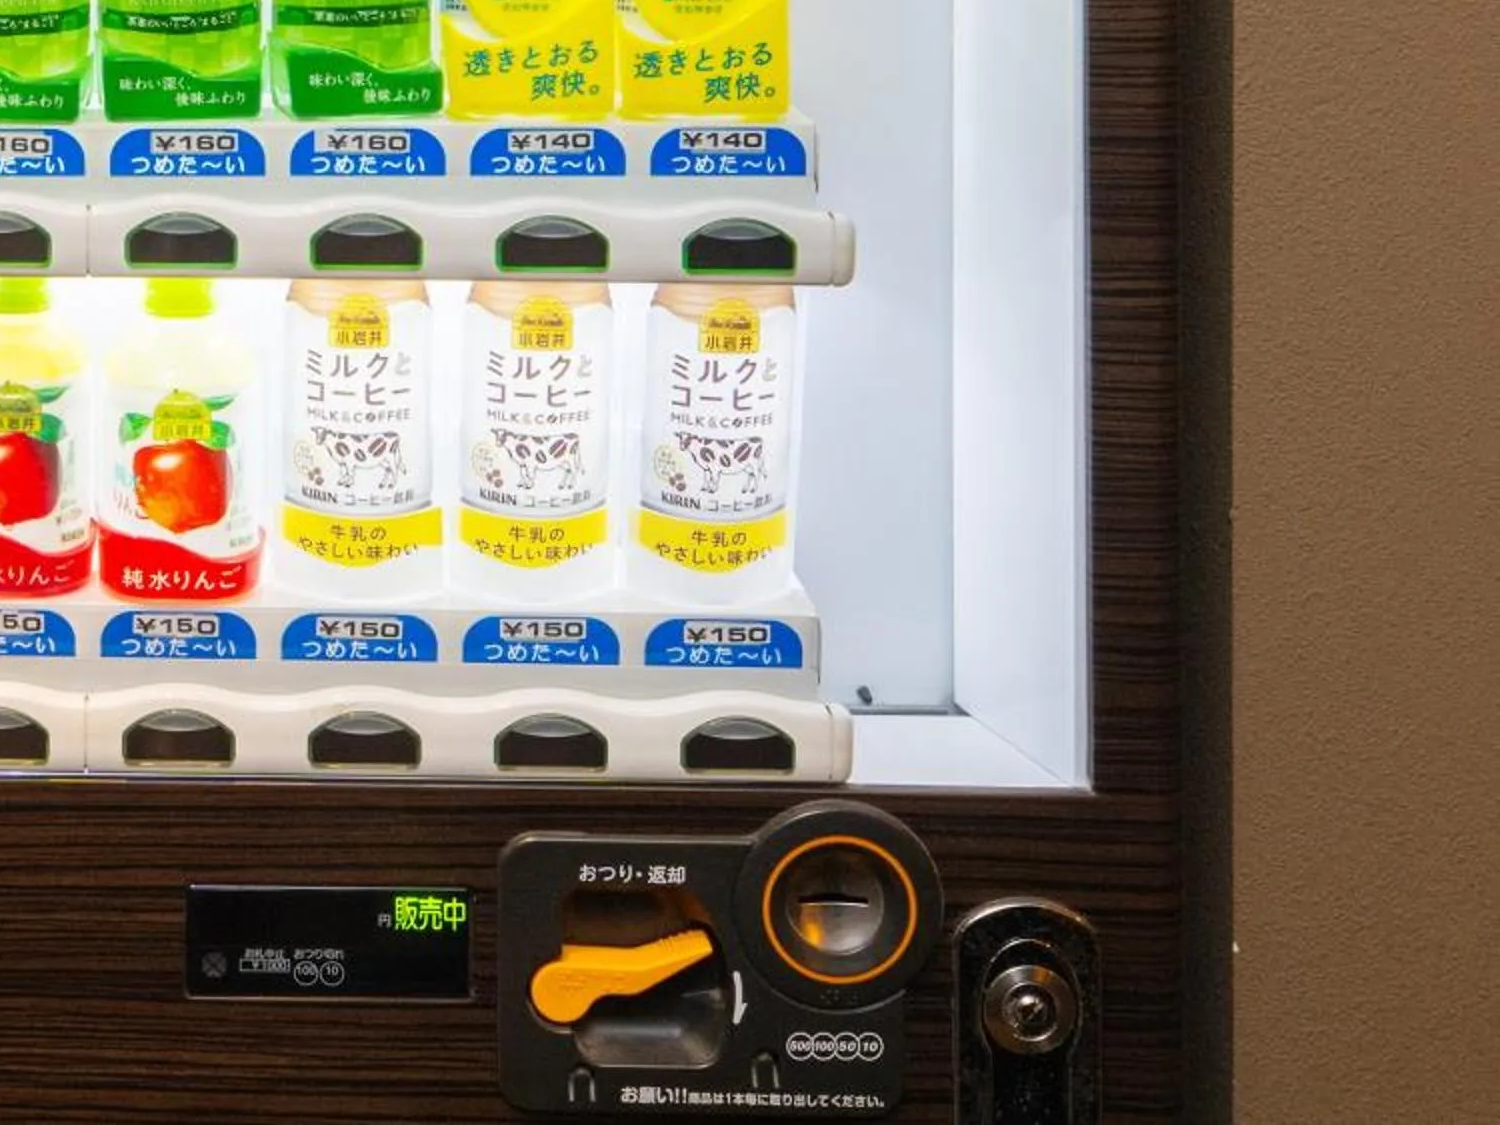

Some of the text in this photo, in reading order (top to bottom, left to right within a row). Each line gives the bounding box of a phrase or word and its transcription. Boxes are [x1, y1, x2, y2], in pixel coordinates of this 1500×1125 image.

[463, 40, 599, 77] 透きとおる
[633, 42, 774, 80] 透きとおる
[531, 73, 601, 102] 爽快。
[704, 74, 777, 104] 爽快。
[155, 135, 235, 151] ¥160
[327, 134, 408, 151] ¥160
[512, 132, 592, 150] ¥140
[682, 131, 764, 149] ¥140
[305, 349, 413, 378] ミルクと
[486, 350, 593, 380] ミルクと
[672, 354, 777, 384] ミルクと
[306, 379, 411, 407] コーヒー
[486, 381, 591, 408] コーヒー
[672, 385, 775, 411] コーヒー
[301, 487, 338, 504] KIRIN
[479, 487, 517, 506] KIRIN
[661, 491, 701, 510] KIRIN
[330, 526, 387, 541] 牛乳の
[508, 526, 565, 541] 牛乳の
[692, 530, 747, 546] 牛乳の
[299, 537, 419, 560] やさしい味わい
[475, 538, 594, 561] やさしい味わい
[656, 543, 773, 565] やさしい味わい
[122, 565, 241, 591] 純水りんご
[136, 618, 217, 635] ¥150
[319, 619, 400, 638] ¥150
[501, 620, 584, 638] ¥150
[687, 626, 768, 643] ¥150
[578, 864, 687, 885] おつり・返却
[394, 896, 467, 931] 販売中
